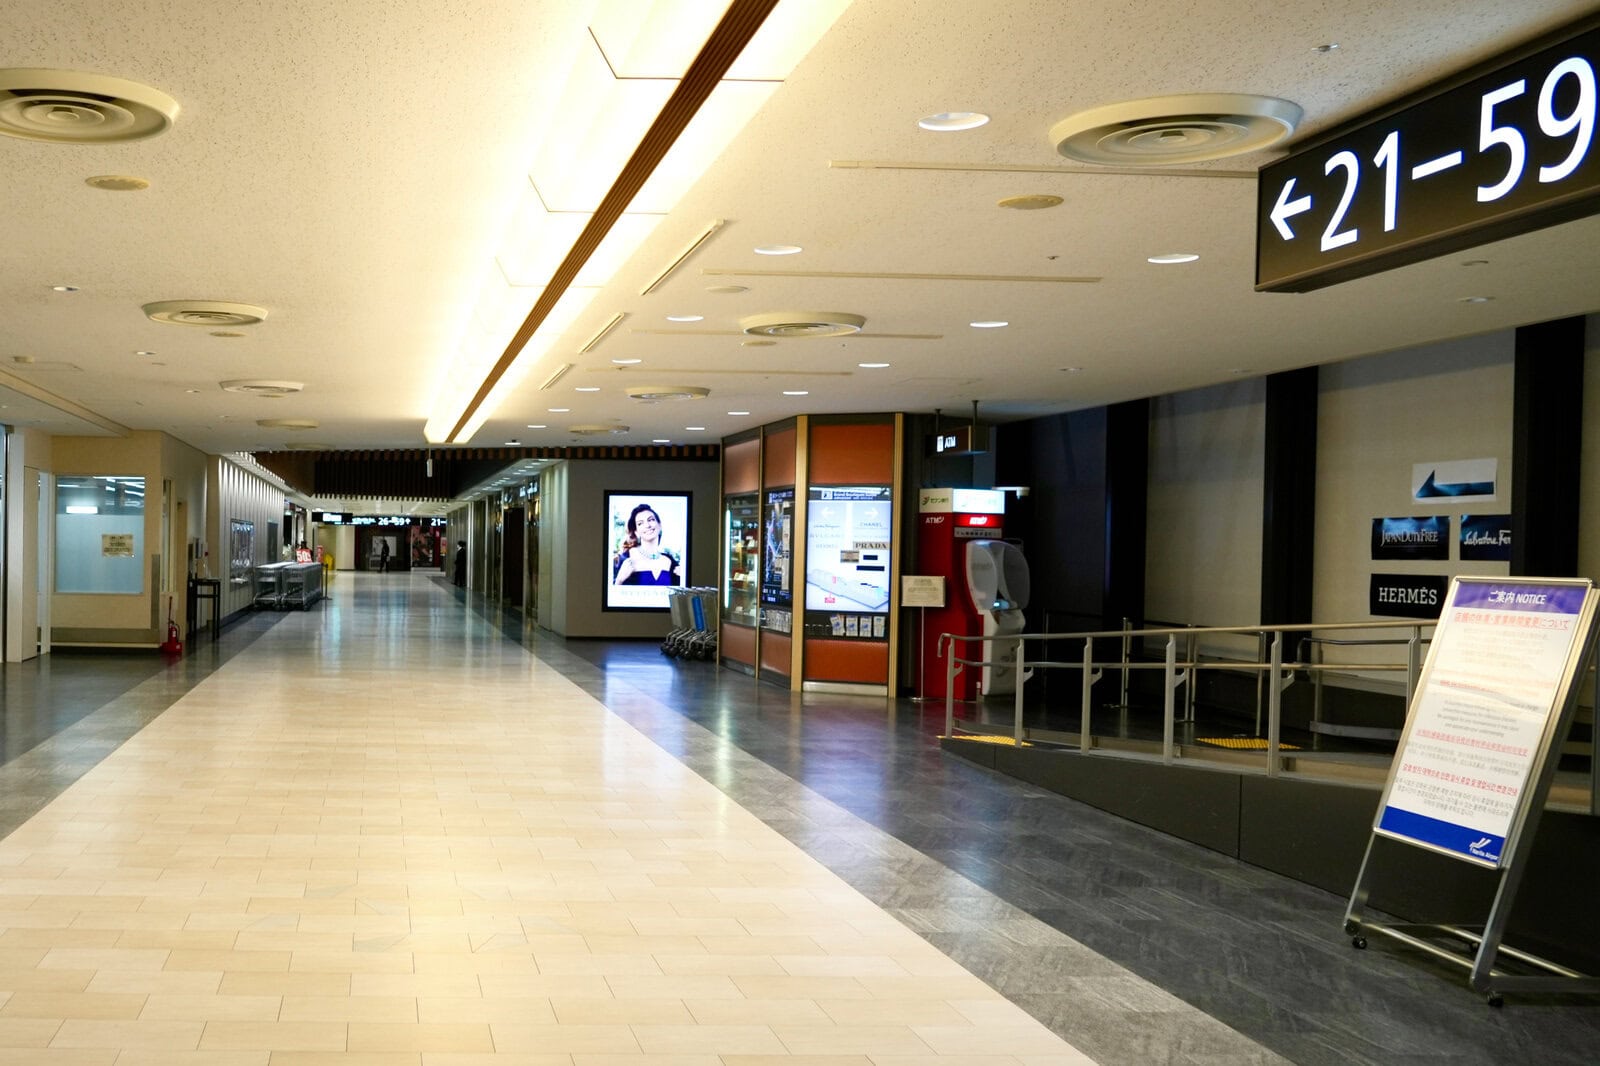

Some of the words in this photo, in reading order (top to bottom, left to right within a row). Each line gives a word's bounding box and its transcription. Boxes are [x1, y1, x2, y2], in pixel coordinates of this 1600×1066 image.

[1320, 57, 1597, 252] 21-59
[945, 436, 956, 448] ATM
[926, 517, 942, 525] ATM
[1487, 590, 1515, 604] ご案内
[1515, 594, 1547, 605] NOTICE
